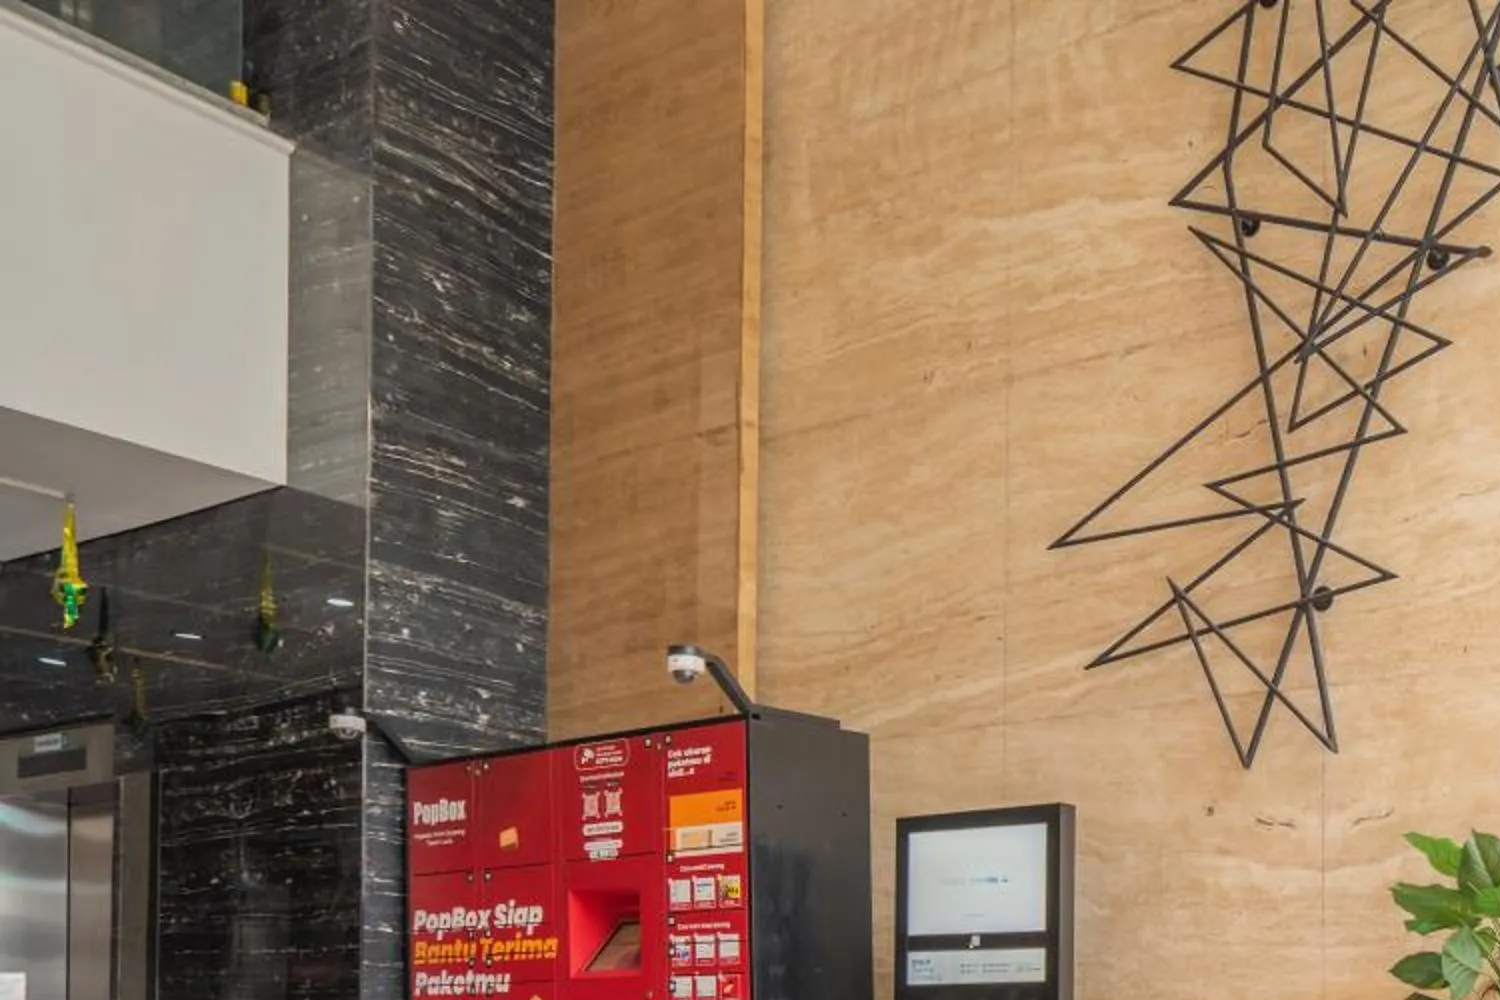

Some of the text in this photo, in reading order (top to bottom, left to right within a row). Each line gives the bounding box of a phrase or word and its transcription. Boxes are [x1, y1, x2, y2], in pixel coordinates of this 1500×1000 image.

[413, 799, 467, 826] PopBox
[413, 900, 543, 937] PopBox Siap
[415, 934, 558, 965] Bantu Terima
[415, 970, 510, 997] Paketmu
